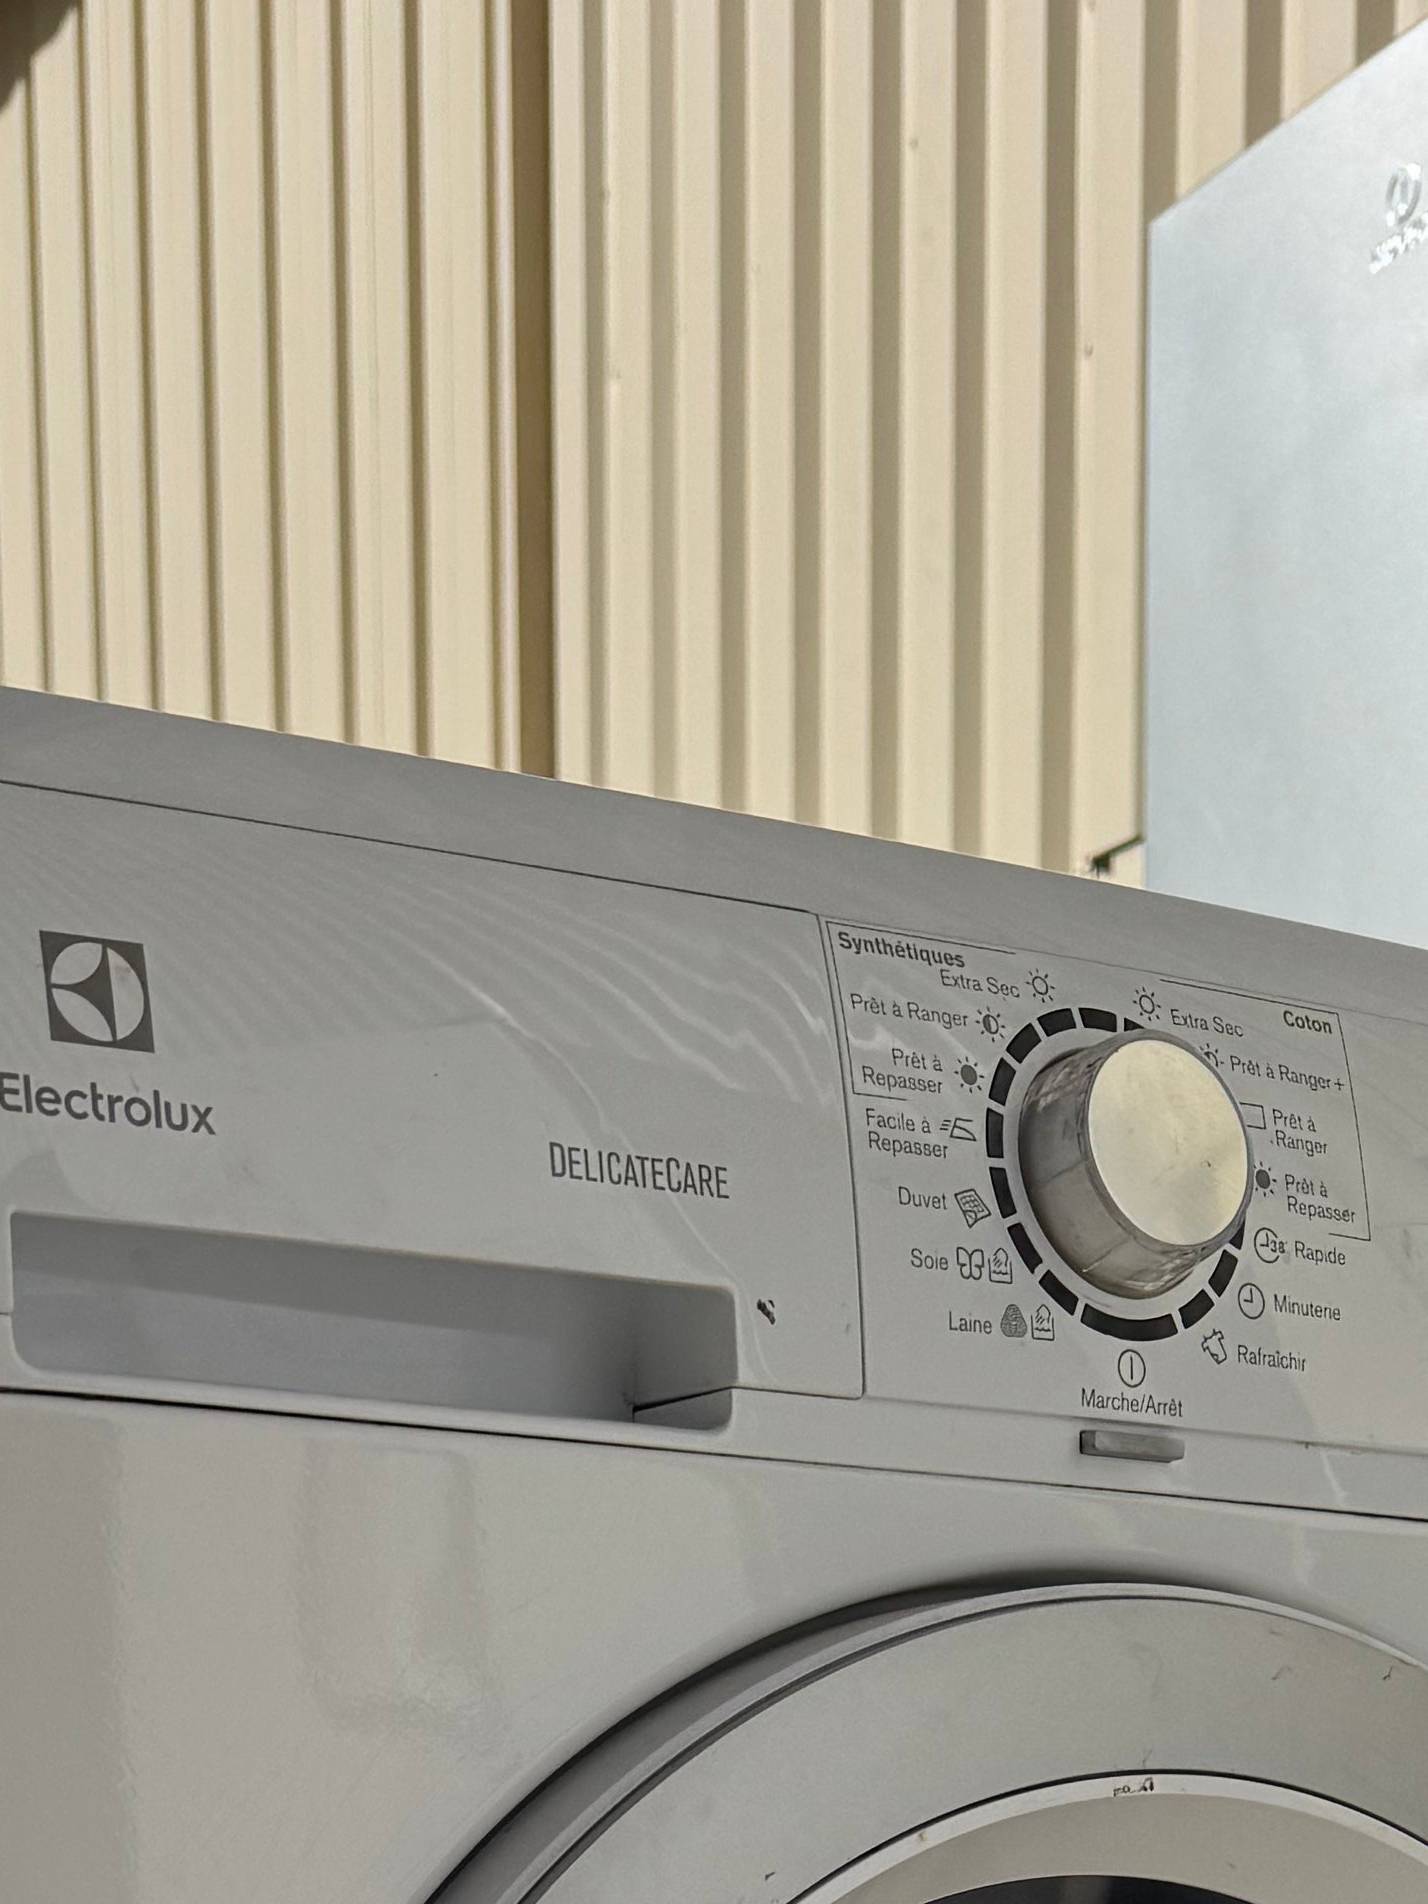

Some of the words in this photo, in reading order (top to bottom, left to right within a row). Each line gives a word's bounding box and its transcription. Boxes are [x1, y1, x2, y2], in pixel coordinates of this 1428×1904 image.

[838, 931, 965, 968] Synthétiques
[940, 968, 982, 992] Extra
[987, 977, 1020, 998] Sec
[850, 993, 885, 1015] Prêt
[892, 1001, 903, 1018] à
[907, 1002, 969, 1030] Ranger
[1170, 1008, 1208, 1031] Extra
[1213, 1016, 1244, 1038] Sec
[1283, 1010, 1333, 1034] Coton
[892, 1048, 928, 1070] Prêt
[932, 1054, 942, 1072] à
[1229, 1055, 1261, 1077] Prêt
[1266, 1063, 1275, 1080] à
[862, 1065, 942, 1094] Repasser
[866, 1108, 916, 1132] Facile
[921, 1116, 931, 1134] à
[1272, 1108, 1304, 1132] Prêt
[1307, 1116, 1316, 1133] à
[868, 1131, 948, 1159] Repasser
[1275, 1130, 1328, 1157] Ranger
[549, 1142, 730, 1200] DELICATECARE
[898, 1186, 948, 1210] Duvet
[1285, 1173, 1315, 1195] Prêt
[1319, 1181, 1328, 1198] à
[1287, 1195, 1356, 1223] Repasser
[910, 1248, 949, 1270] Soie
[1295, 1241, 1346, 1265] Rapide
[1274, 1294, 1341, 1321] Minuterie
[948, 1310, 992, 1334] Laine
[1238, 1344, 1306, 1372] Rafraîchir
[1080, 1388, 1183, 1417] Marche/Arrêt
